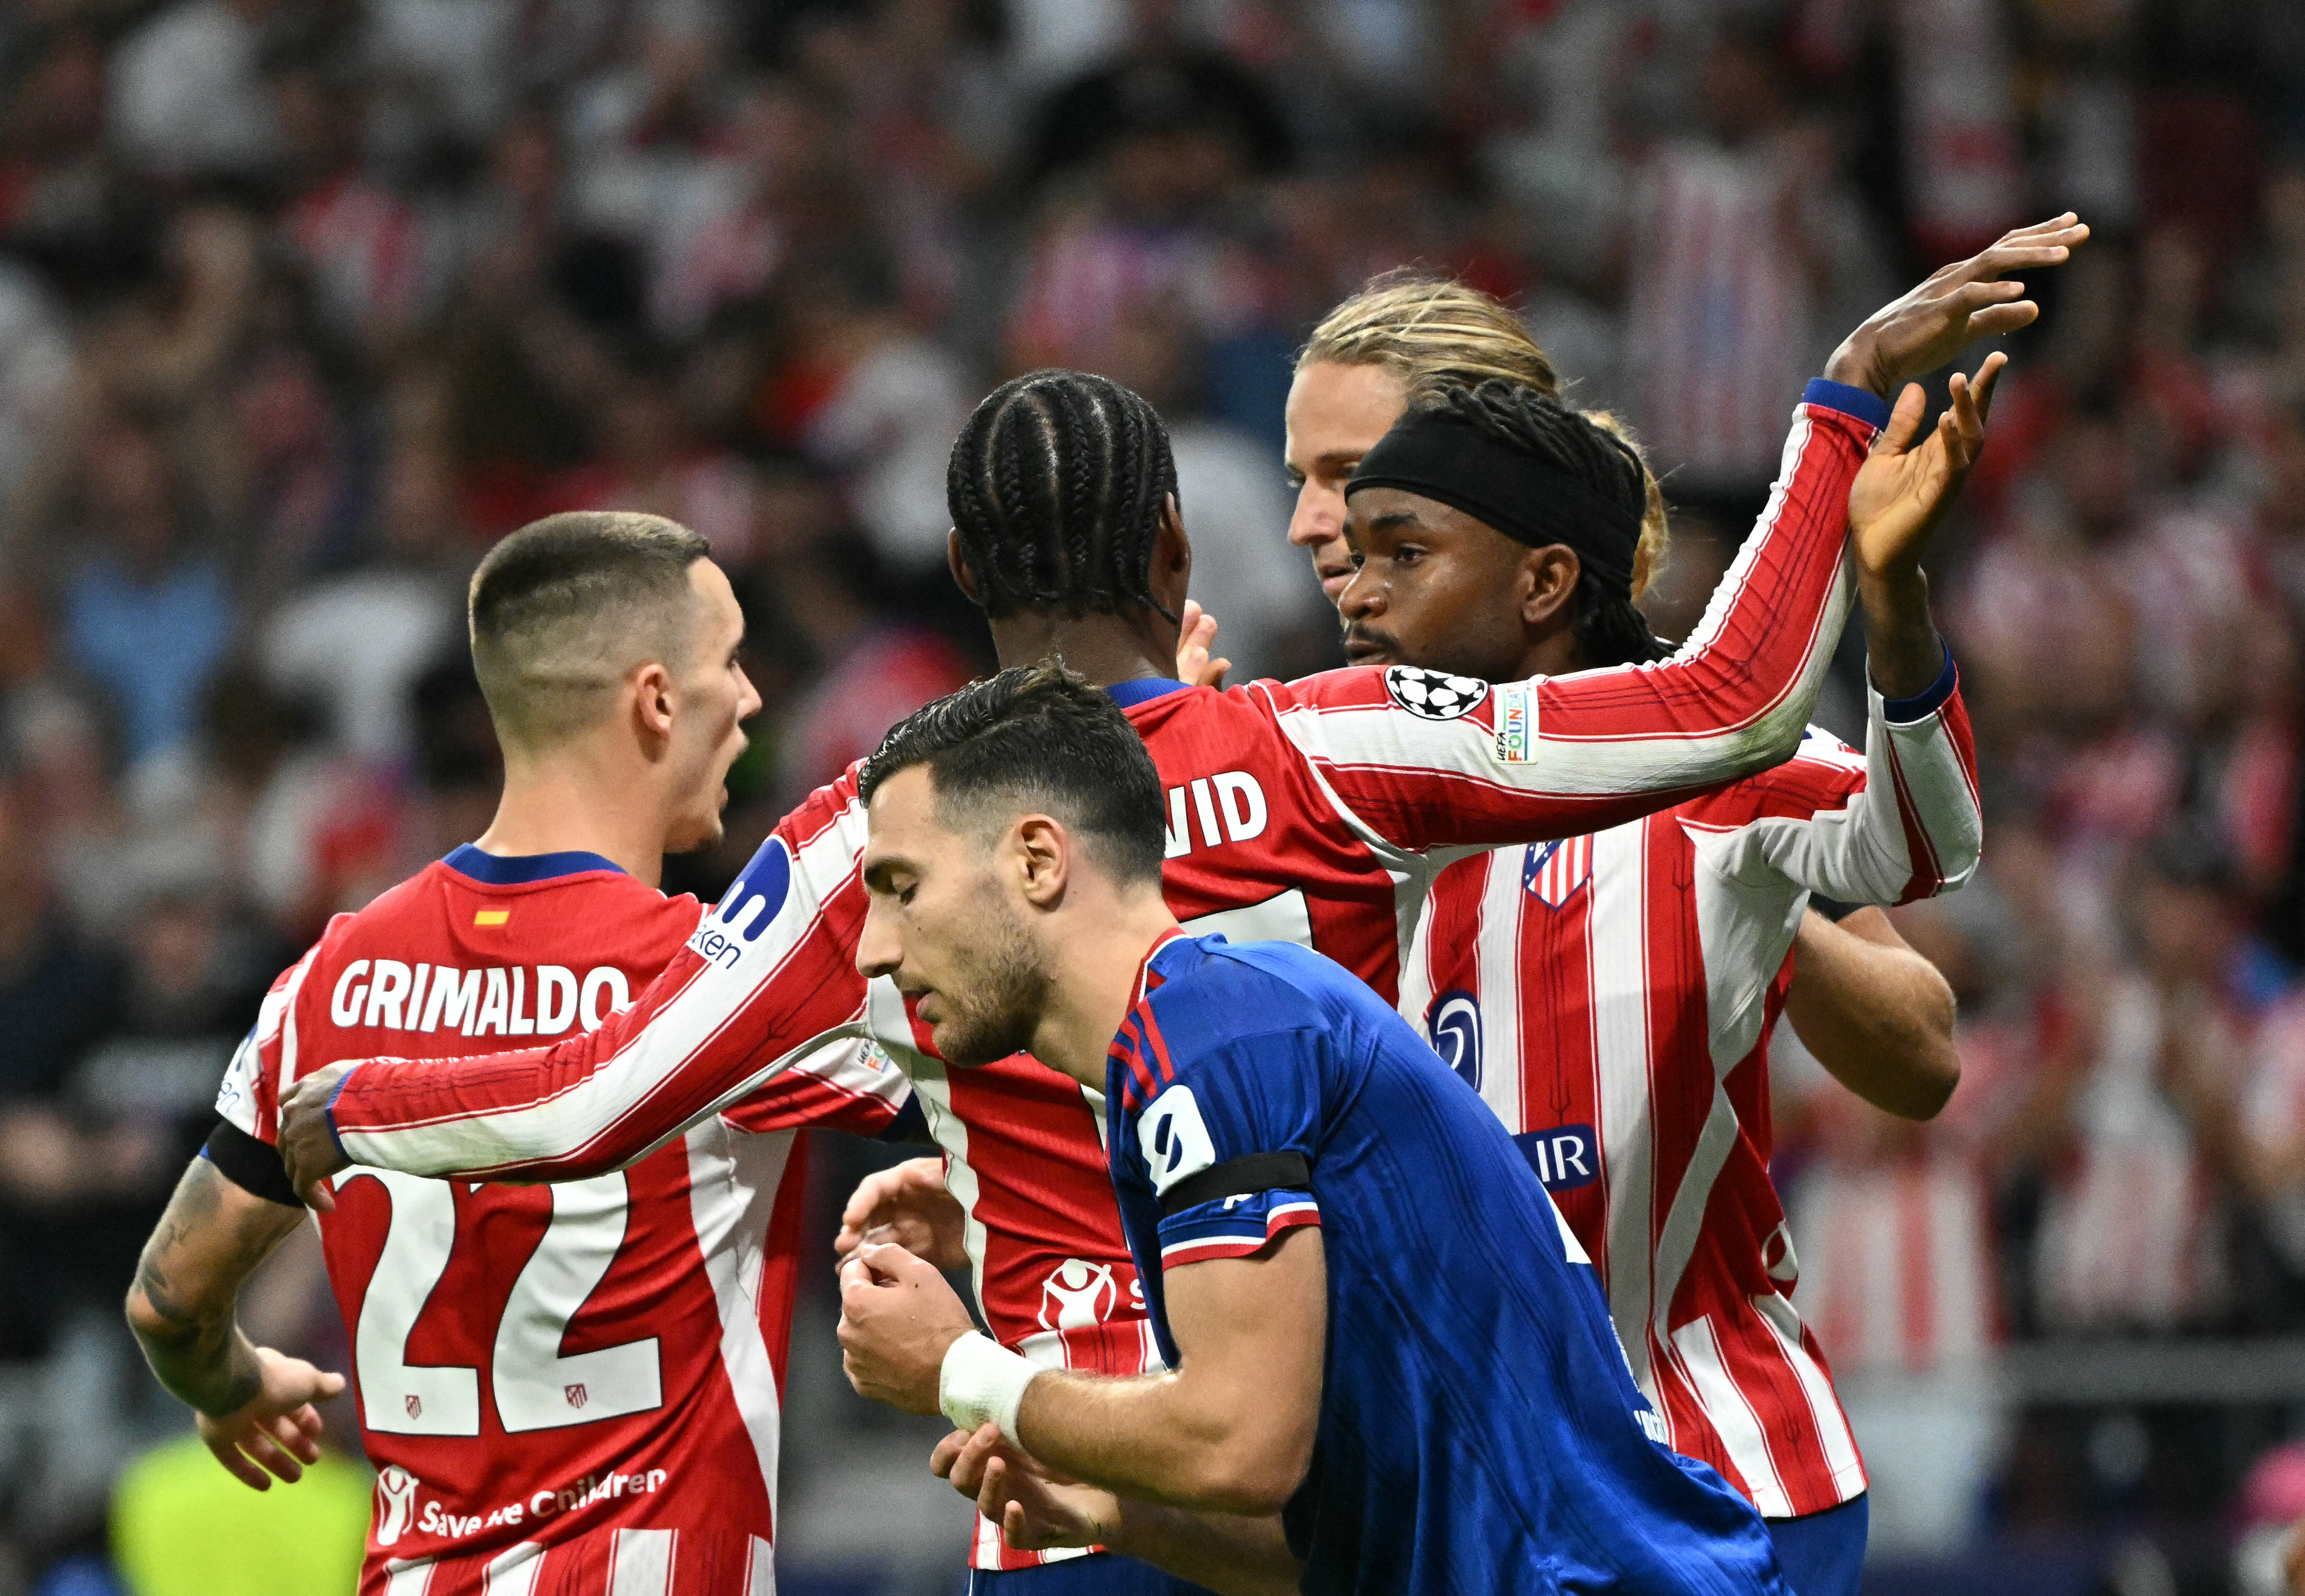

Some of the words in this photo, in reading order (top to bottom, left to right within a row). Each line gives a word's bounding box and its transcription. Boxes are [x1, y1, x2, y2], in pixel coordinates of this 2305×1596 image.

[1496, 731, 1506, 761] UEFA
[330, 959, 629, 1037] GRIMALDO
[331, 1165, 663, 1436] 22
[418, 1500, 482, 1538] Save
